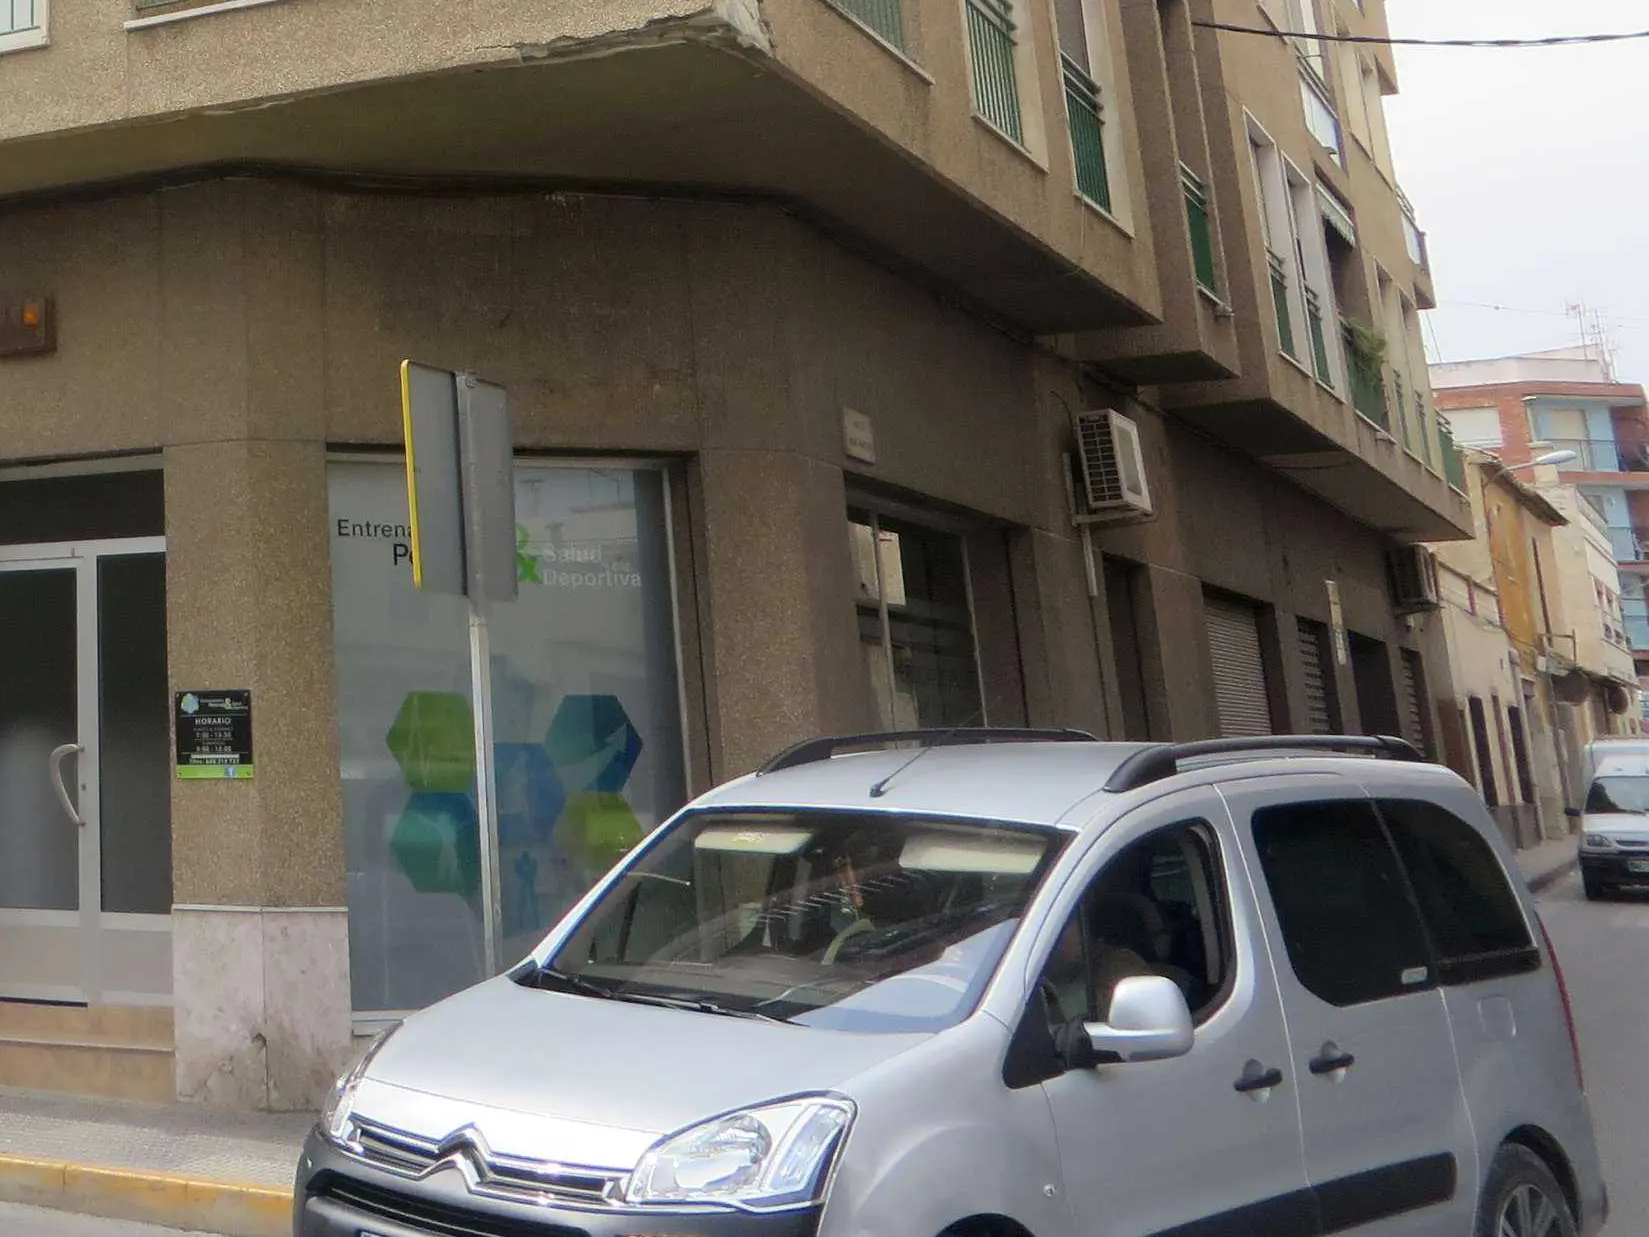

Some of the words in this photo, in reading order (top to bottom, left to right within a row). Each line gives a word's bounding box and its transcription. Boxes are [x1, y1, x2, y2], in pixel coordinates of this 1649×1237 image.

[393, 544, 413, 565] P
[543, 545, 602, 562] Salud
[543, 569, 641, 588] Deportiva
[195, 717, 232, 725] HORARIO
